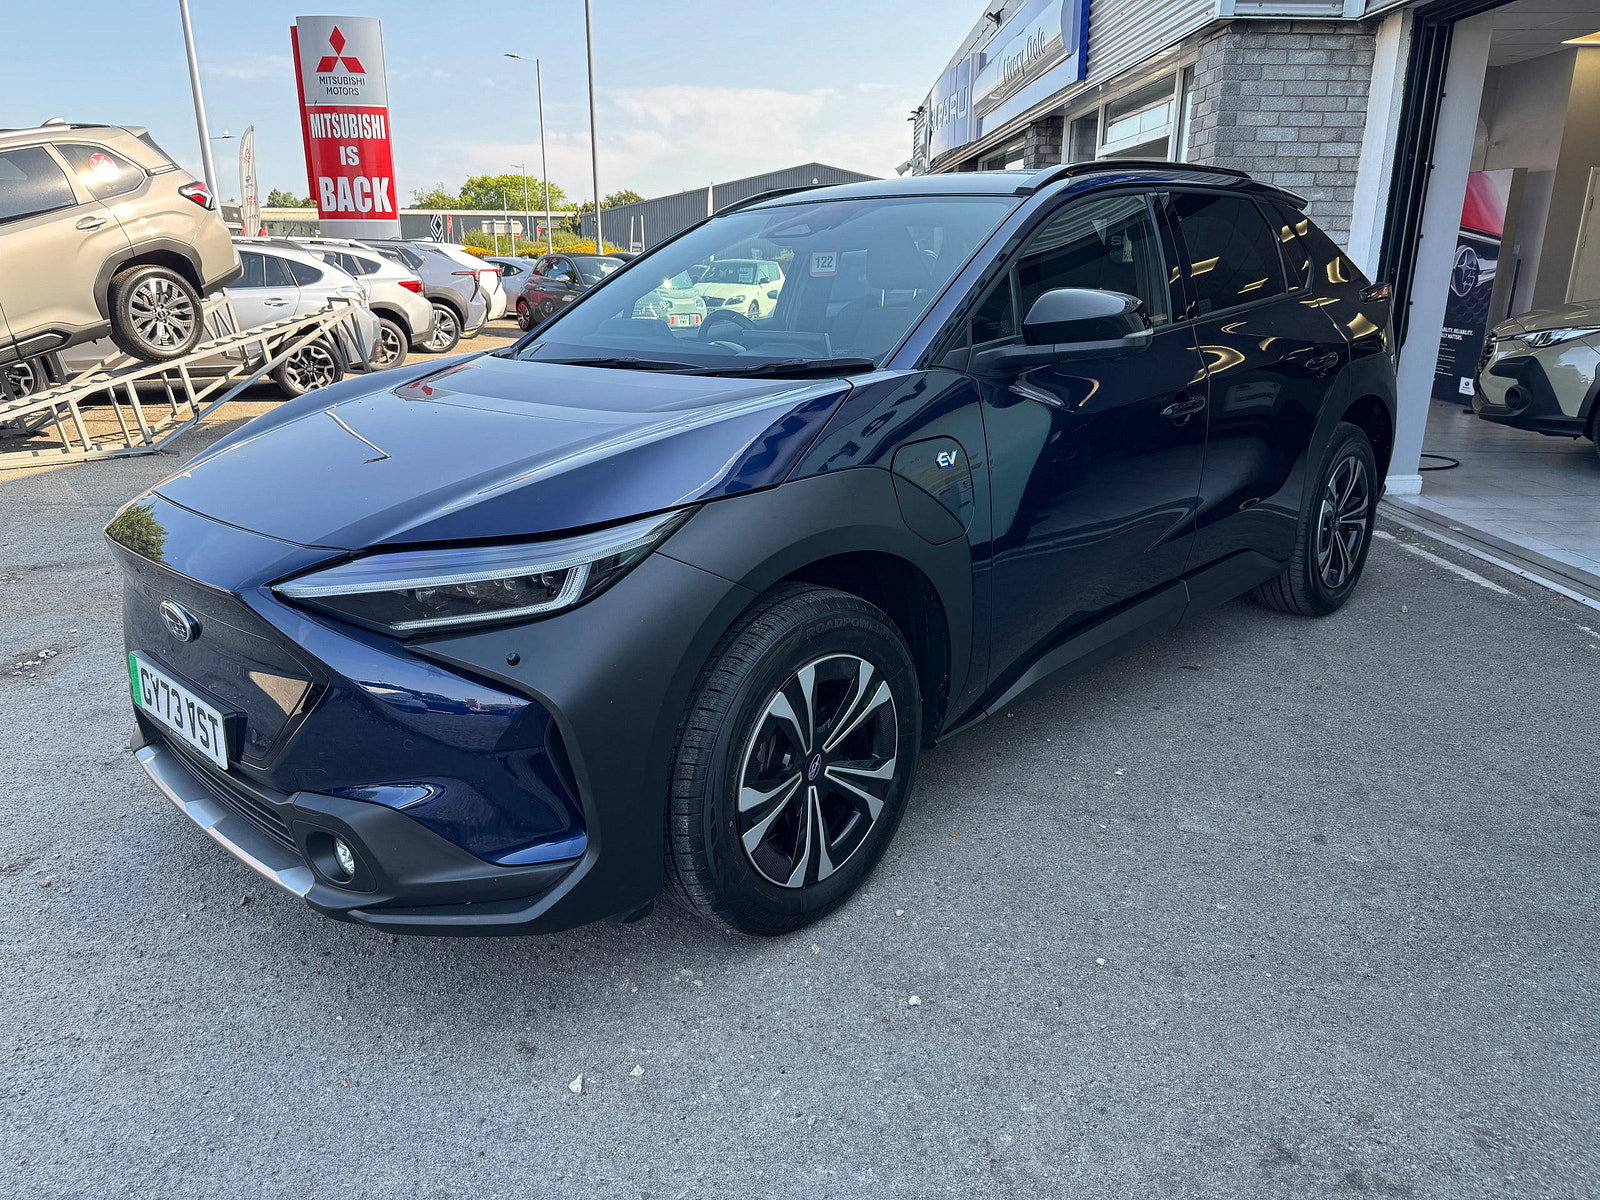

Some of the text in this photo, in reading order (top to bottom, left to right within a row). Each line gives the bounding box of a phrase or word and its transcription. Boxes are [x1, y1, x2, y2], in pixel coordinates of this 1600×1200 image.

[319, 76, 366, 86] MITSUBISHI
[326, 87, 360, 96] MOTORS
[932, 85, 969, 132] BARU
[309, 113, 387, 140] MITSUBISHI
[339, 145, 360, 166] IS
[318, 176, 393, 213] BACK
[815, 255, 834, 269] 122
[936, 450, 958, 468] EV
[140, 667, 219, 758] GY73 YST
